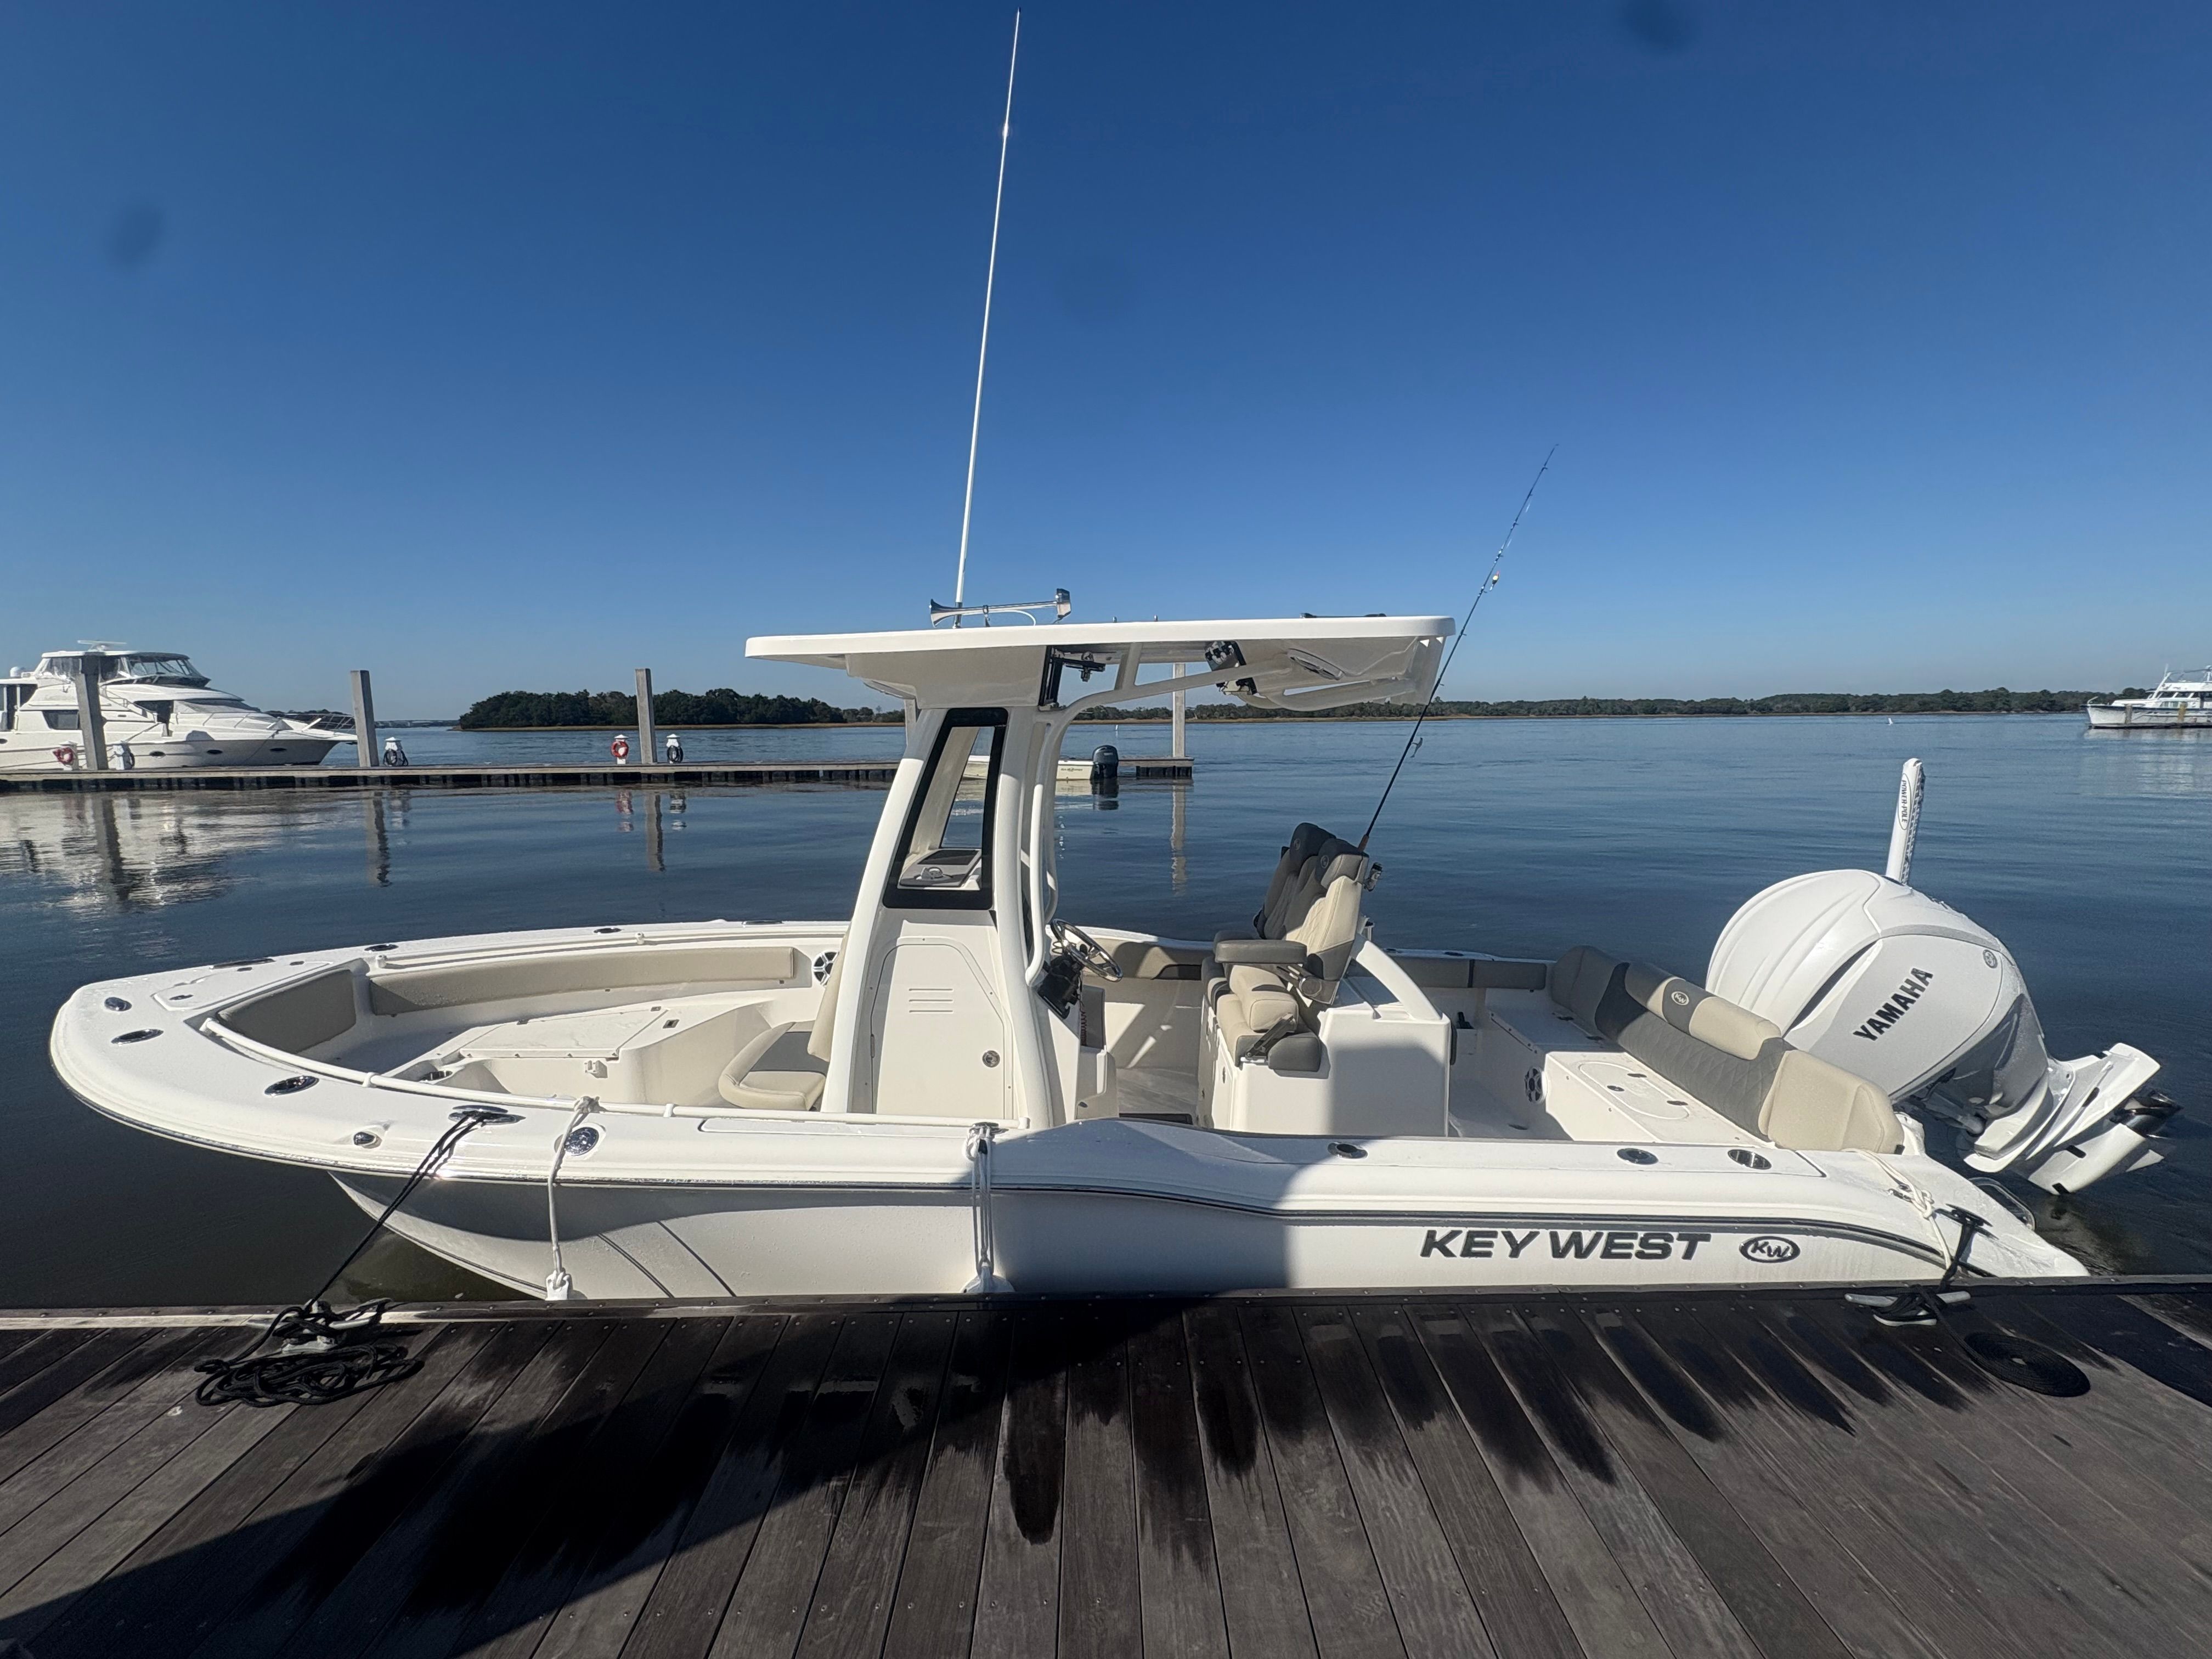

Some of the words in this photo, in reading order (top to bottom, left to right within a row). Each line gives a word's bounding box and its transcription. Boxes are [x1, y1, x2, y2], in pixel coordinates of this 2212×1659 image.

[1674, 993, 1686, 1003] KW
[1853, 967, 1934, 1041] YAMAHA
[1420, 1229, 1541, 1259] KEY
[1549, 1231, 1712, 1261] WEST
[1751, 1240, 1790, 1257] KW
